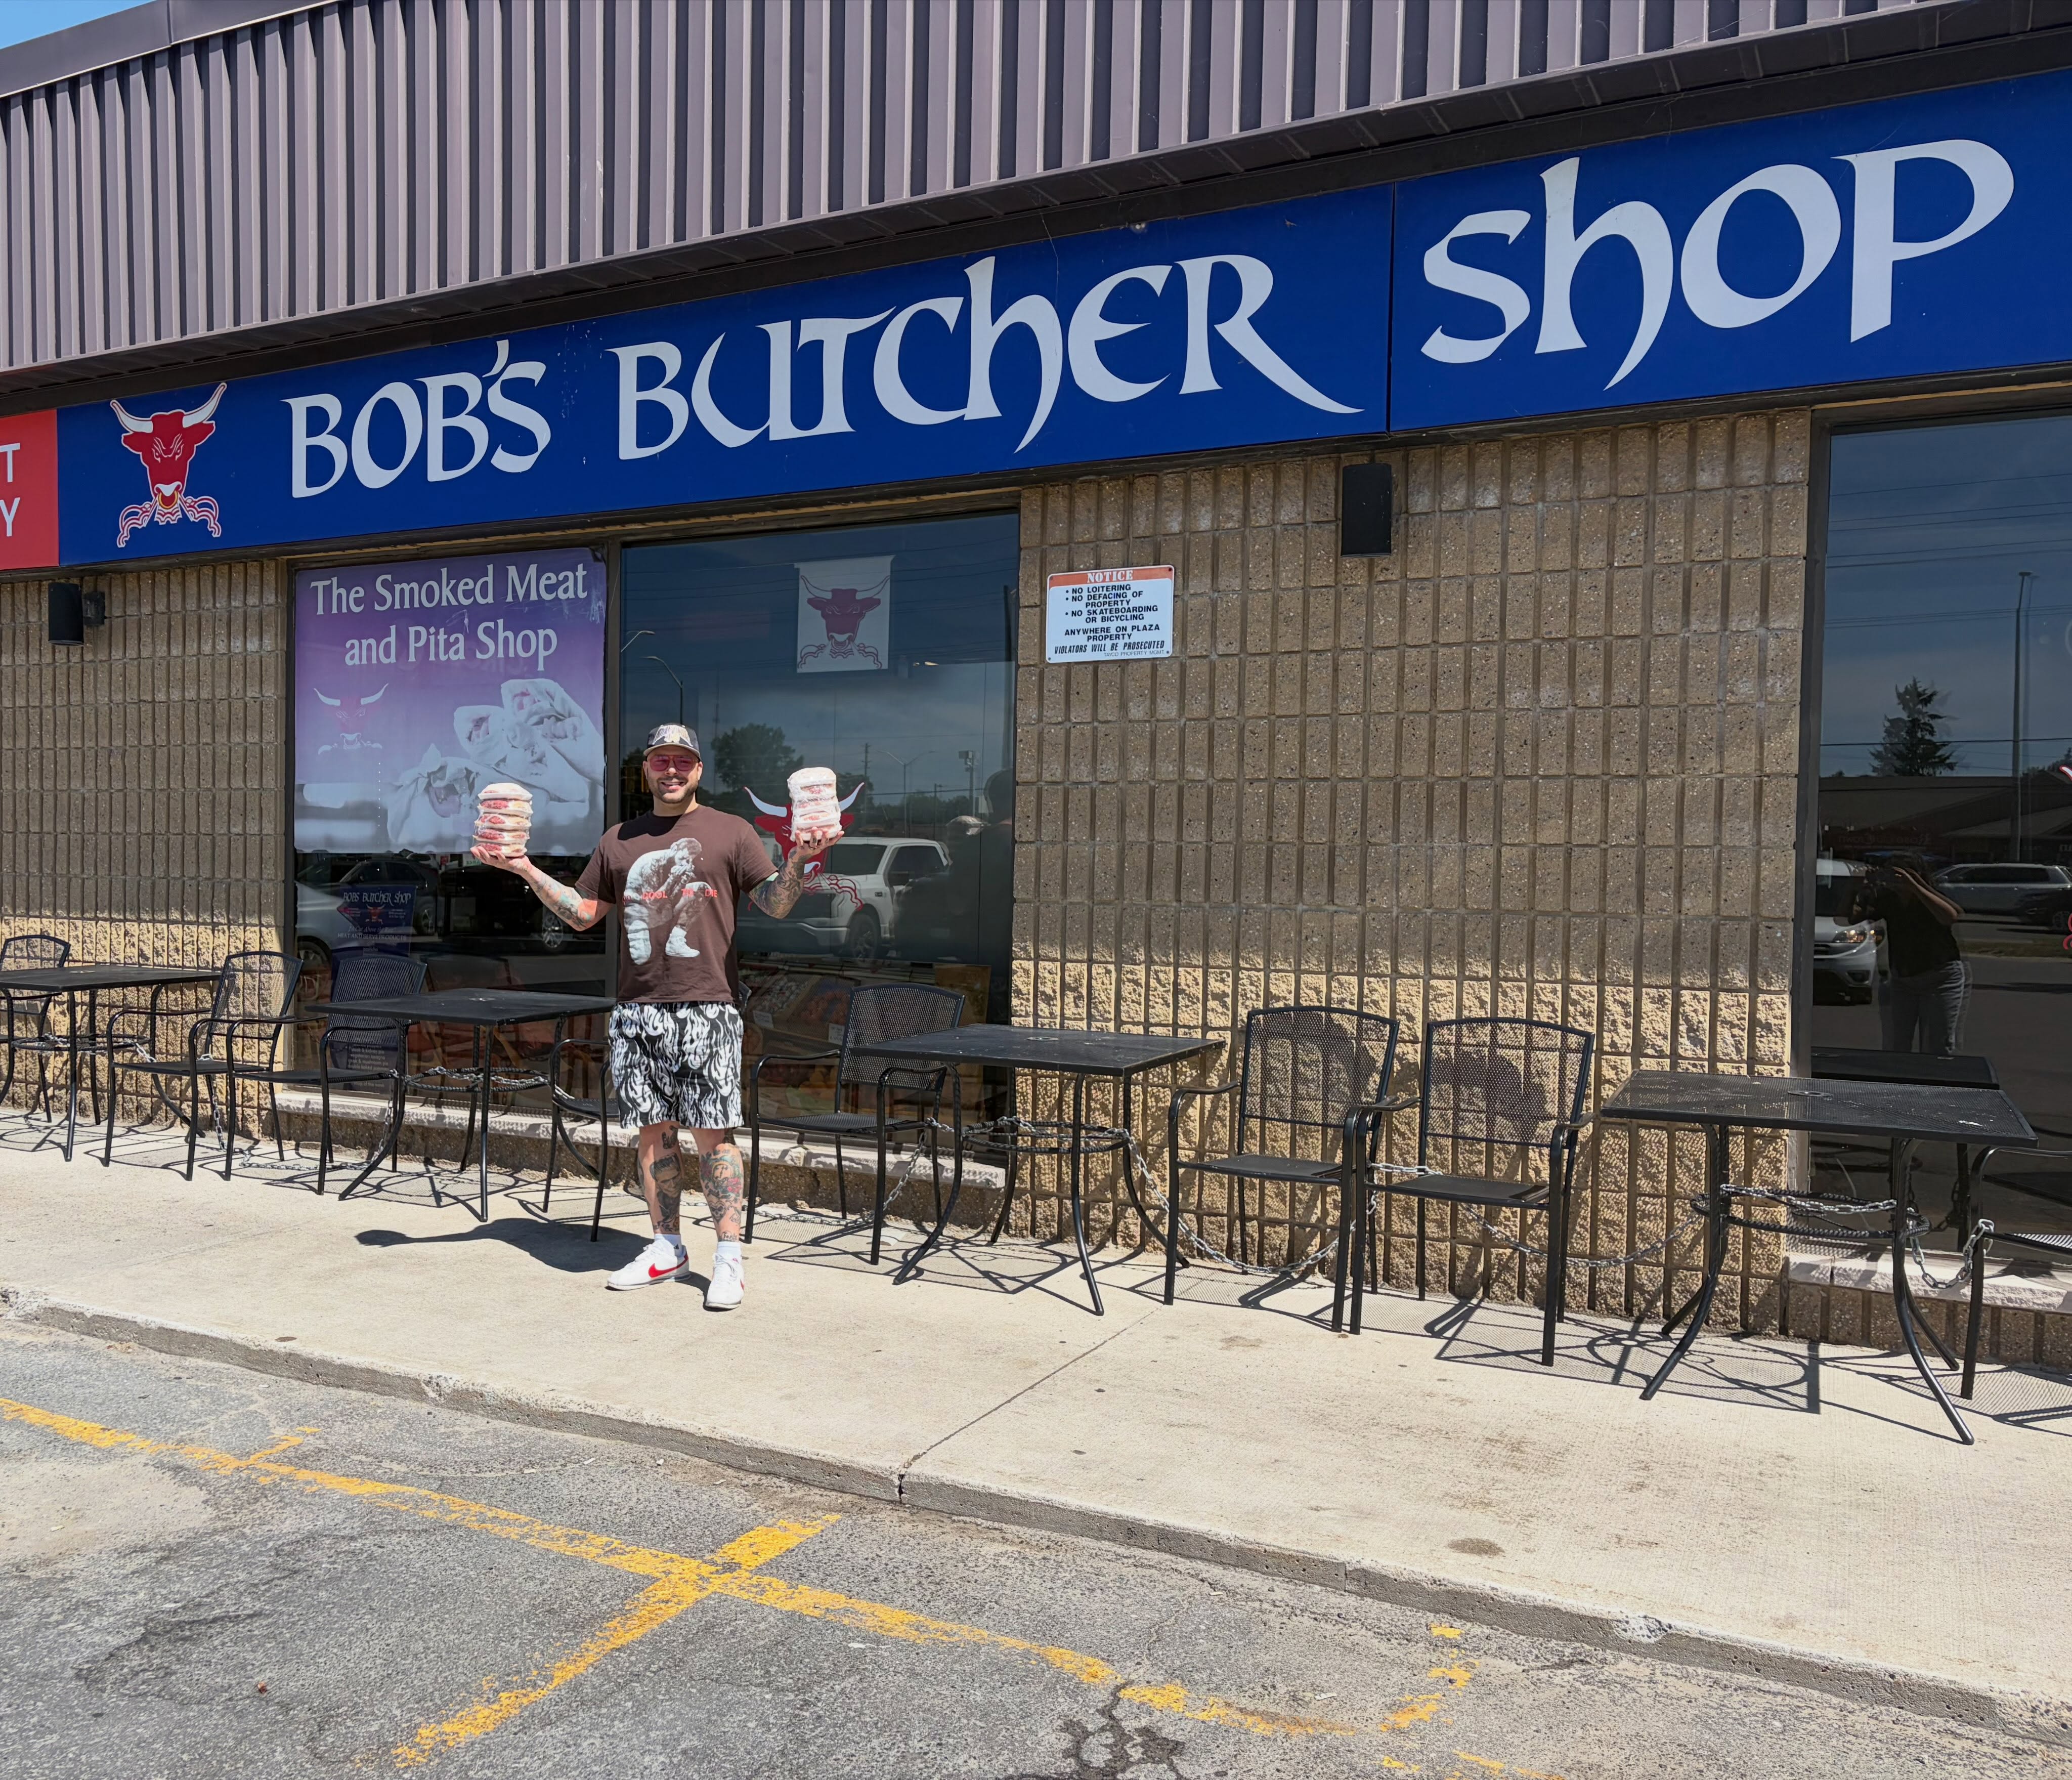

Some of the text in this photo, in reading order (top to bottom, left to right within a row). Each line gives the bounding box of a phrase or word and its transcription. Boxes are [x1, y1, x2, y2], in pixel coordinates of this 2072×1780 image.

[282, 341, 551, 498] BOB'S
[606, 255, 1364, 460] BUTCHER
[1087, 570, 1133, 583] NOTICE
[310, 563, 588, 615] The Smoked Meat
[1087, 584, 1131, 594] LOITERING
[1087, 592, 1127, 601] DEFACING
[1086, 599, 1131, 608] PROPERTY
[1087, 605, 1158, 616] SKATEBOARDING
[1101, 614, 1144, 622] BICYCLING
[1065, 626, 1111, 636] ANYWHERE
[1132, 624, 1160, 632] PLAZA
[1087, 633, 1132, 642] PROPERTY
[345, 618, 557, 671] and Pita Shop
[1055, 641, 1164, 654] VIOLATORS WILL BE PROSECUTED
[705, 889, 718, 898] DIE
